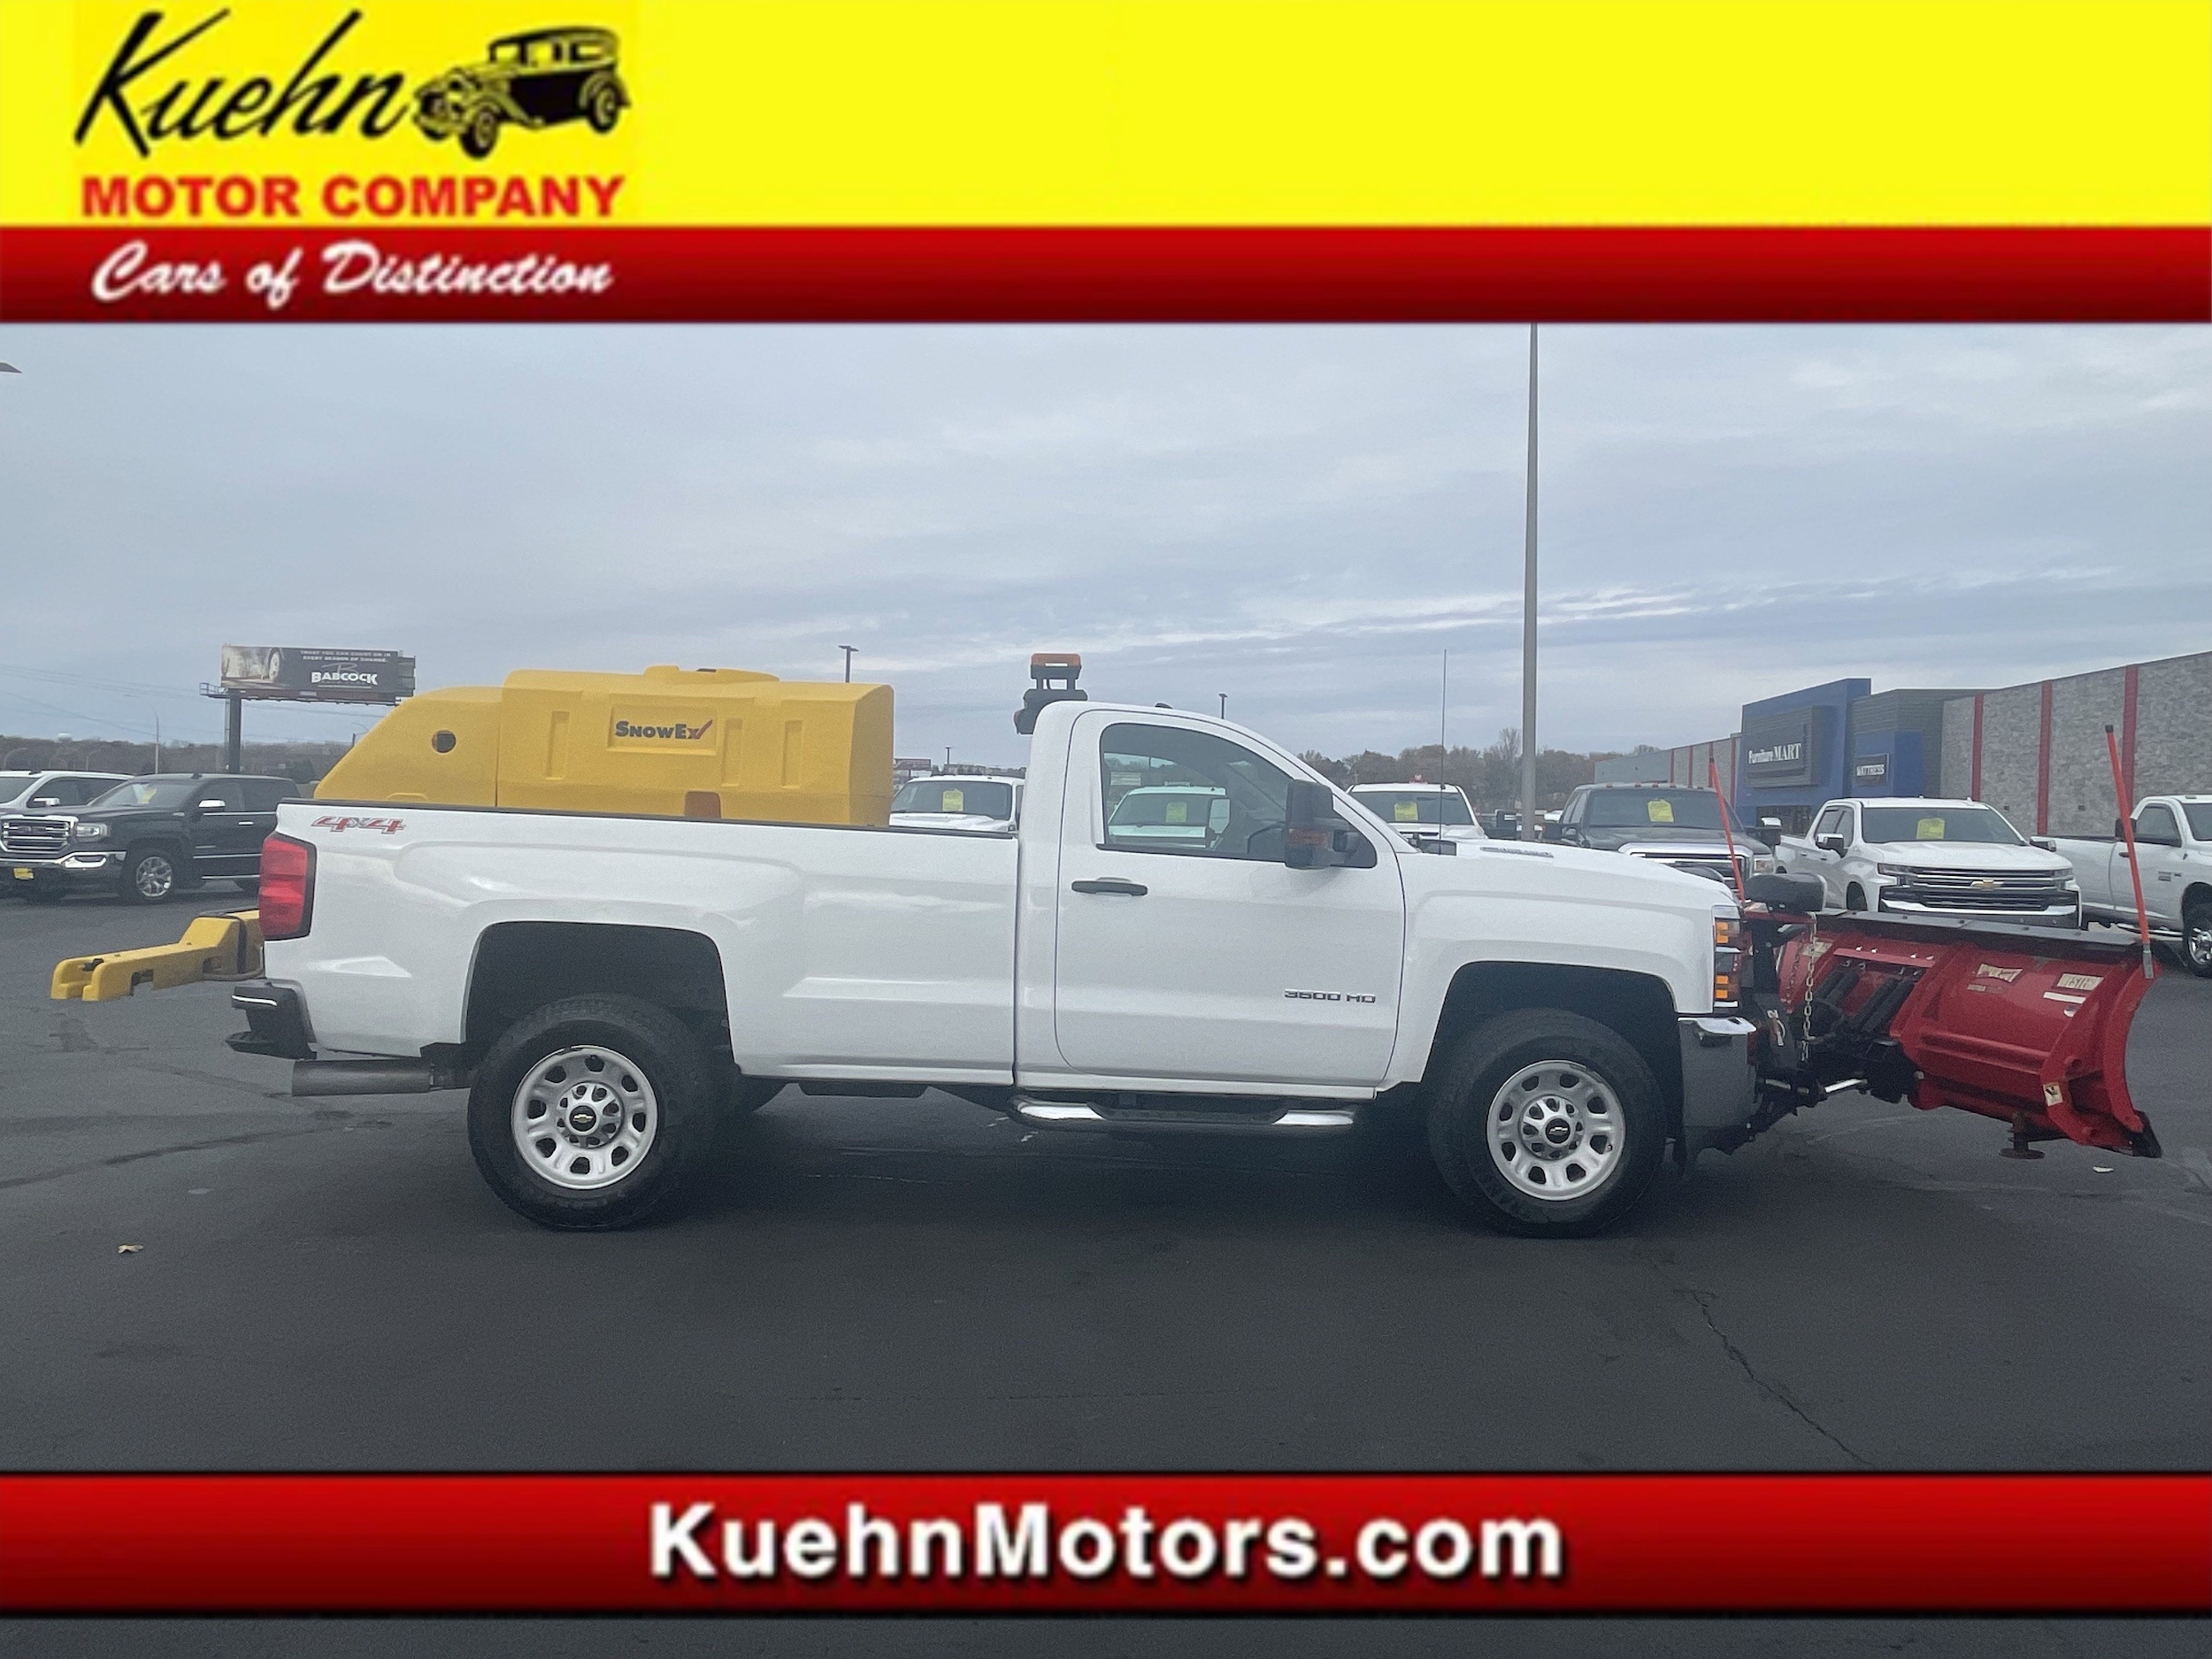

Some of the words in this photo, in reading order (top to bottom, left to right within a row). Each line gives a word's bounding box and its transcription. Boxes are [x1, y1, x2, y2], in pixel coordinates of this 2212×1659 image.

[311, 672, 378, 686] BABCOCK
[1285, 989, 1341, 1002] 3500
[1346, 994, 1376, 1003] HD
